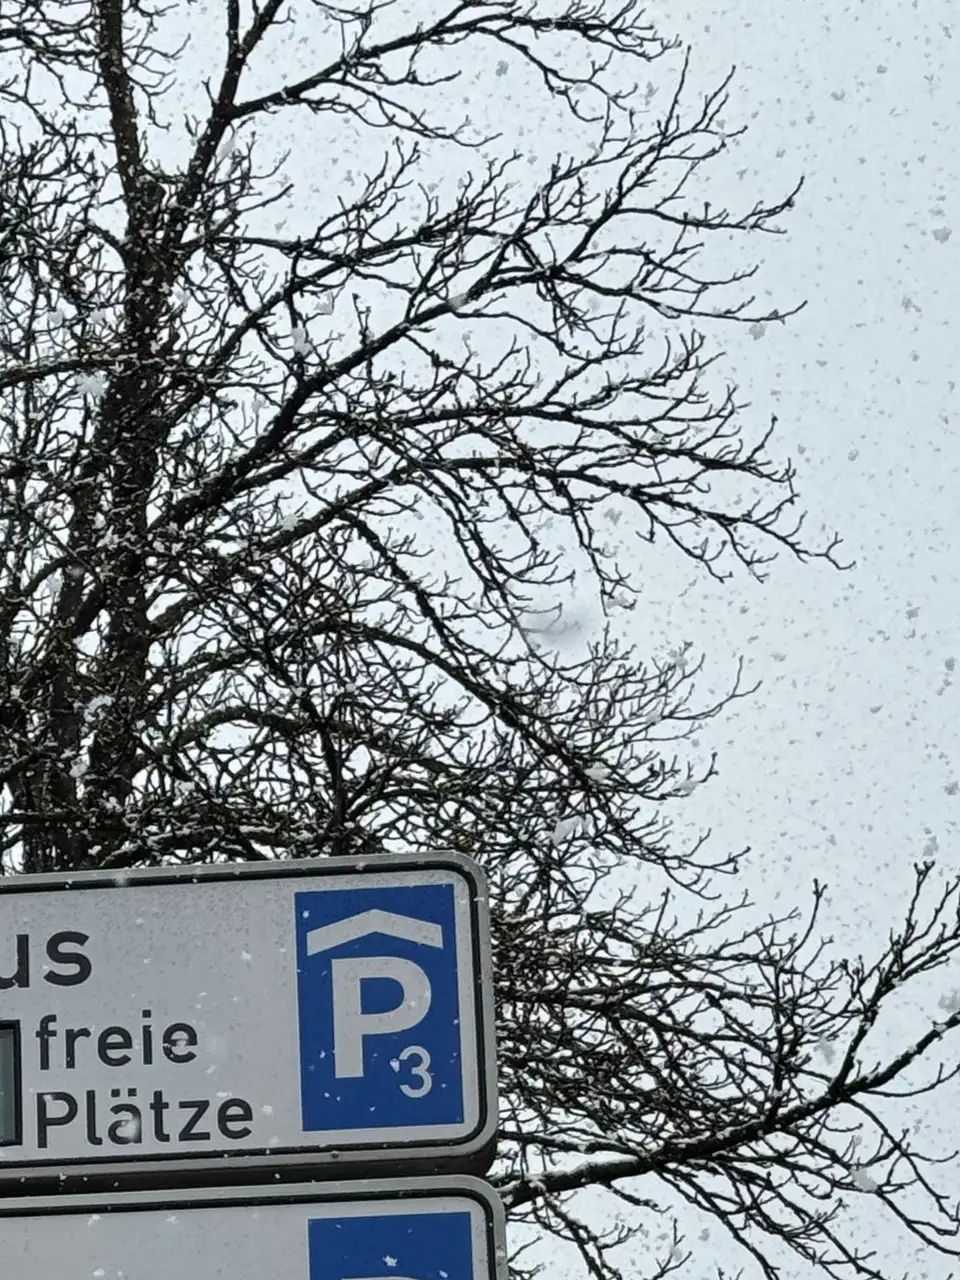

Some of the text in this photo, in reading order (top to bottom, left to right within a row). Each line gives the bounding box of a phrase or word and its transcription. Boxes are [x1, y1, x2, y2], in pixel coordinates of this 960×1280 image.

[36, 1010, 197, 1070] freie
[332, 956, 432, 1098] P 3
[37, 1088, 252, 1148] Plätze
